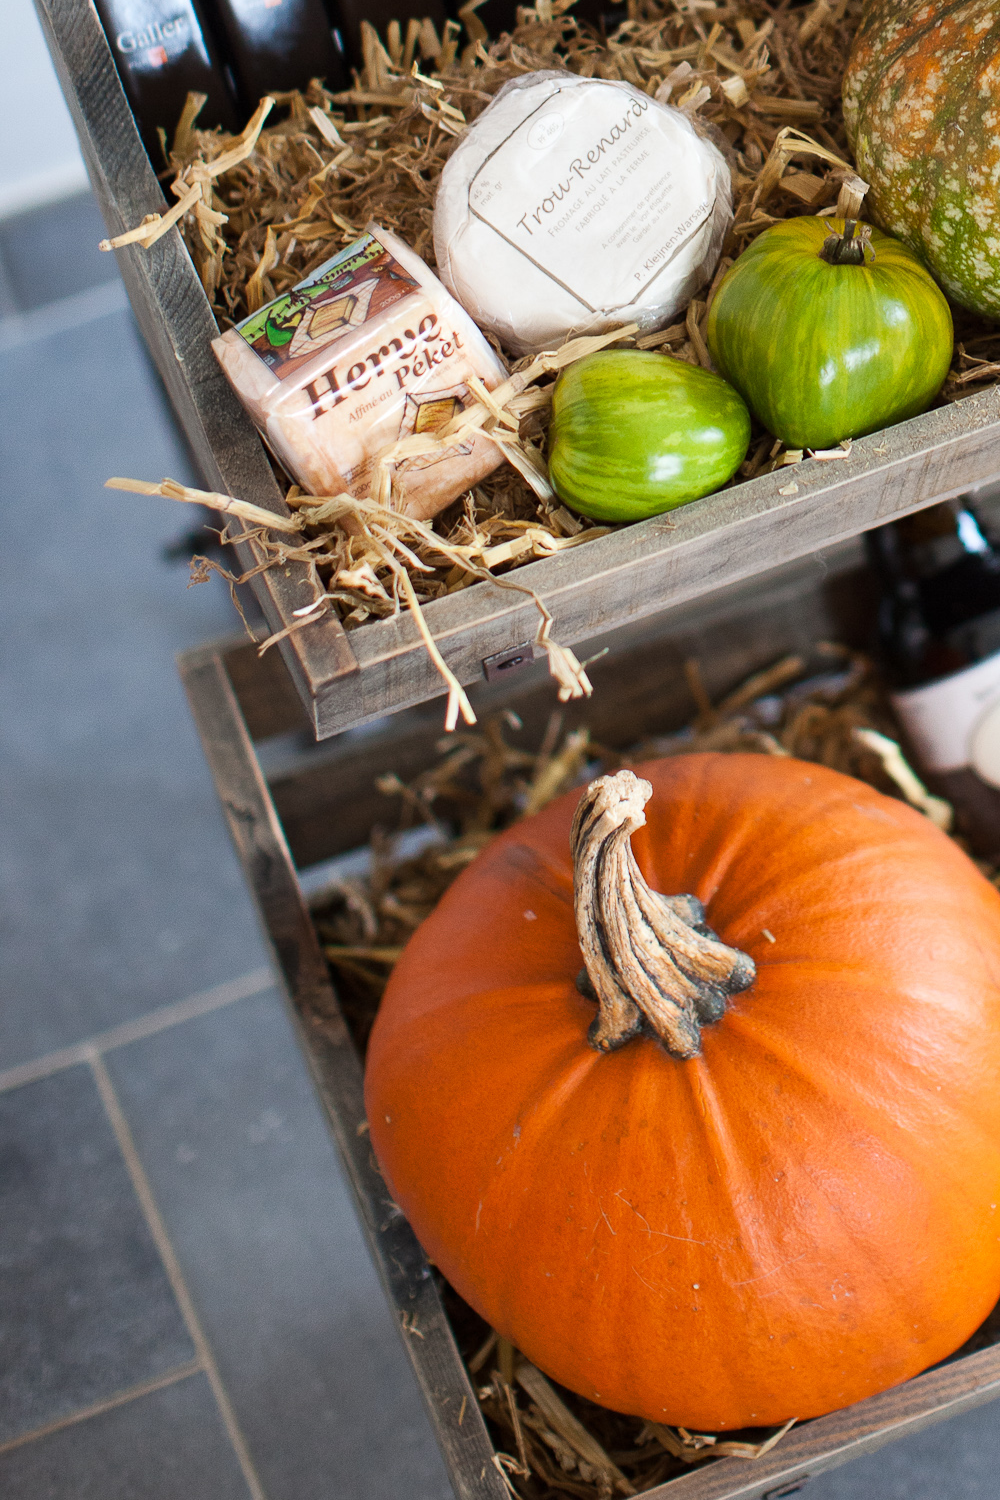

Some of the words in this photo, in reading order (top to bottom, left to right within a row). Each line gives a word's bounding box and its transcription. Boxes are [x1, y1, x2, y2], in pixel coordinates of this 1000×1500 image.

[116, 17, 184, 53] Galler
[473, 188, 483, 200] 45
[516, 98, 648, 235] Trou-Renard
[547, 198, 585, 238] FROMAGE
[584, 185, 597, 197] AU
[596, 167, 612, 184] LAIT
[611, 126, 652, 167] PASTEURISE
[575, 194, 610, 232] FABRIQUÉ
[616, 175, 627, 186] LA
[626, 149, 651, 174] FERME
[607, 209, 638, 244] consommer
[636, 200, 645, 210] de
[644, 170, 672, 203] préférence
[616, 230, 631, 249] avant
[639, 210, 651, 222] voir
[632, 223, 652, 244] Garder
[652, 215, 660, 225] au
[657, 201, 672, 215] frais
[634, 272, 646, 281] P.
[302, 313, 442, 421] Herve
[349, 399, 378, 424] Affiné
[380, 389, 394, 402] au
[393, 331, 464, 391] Pékèt
